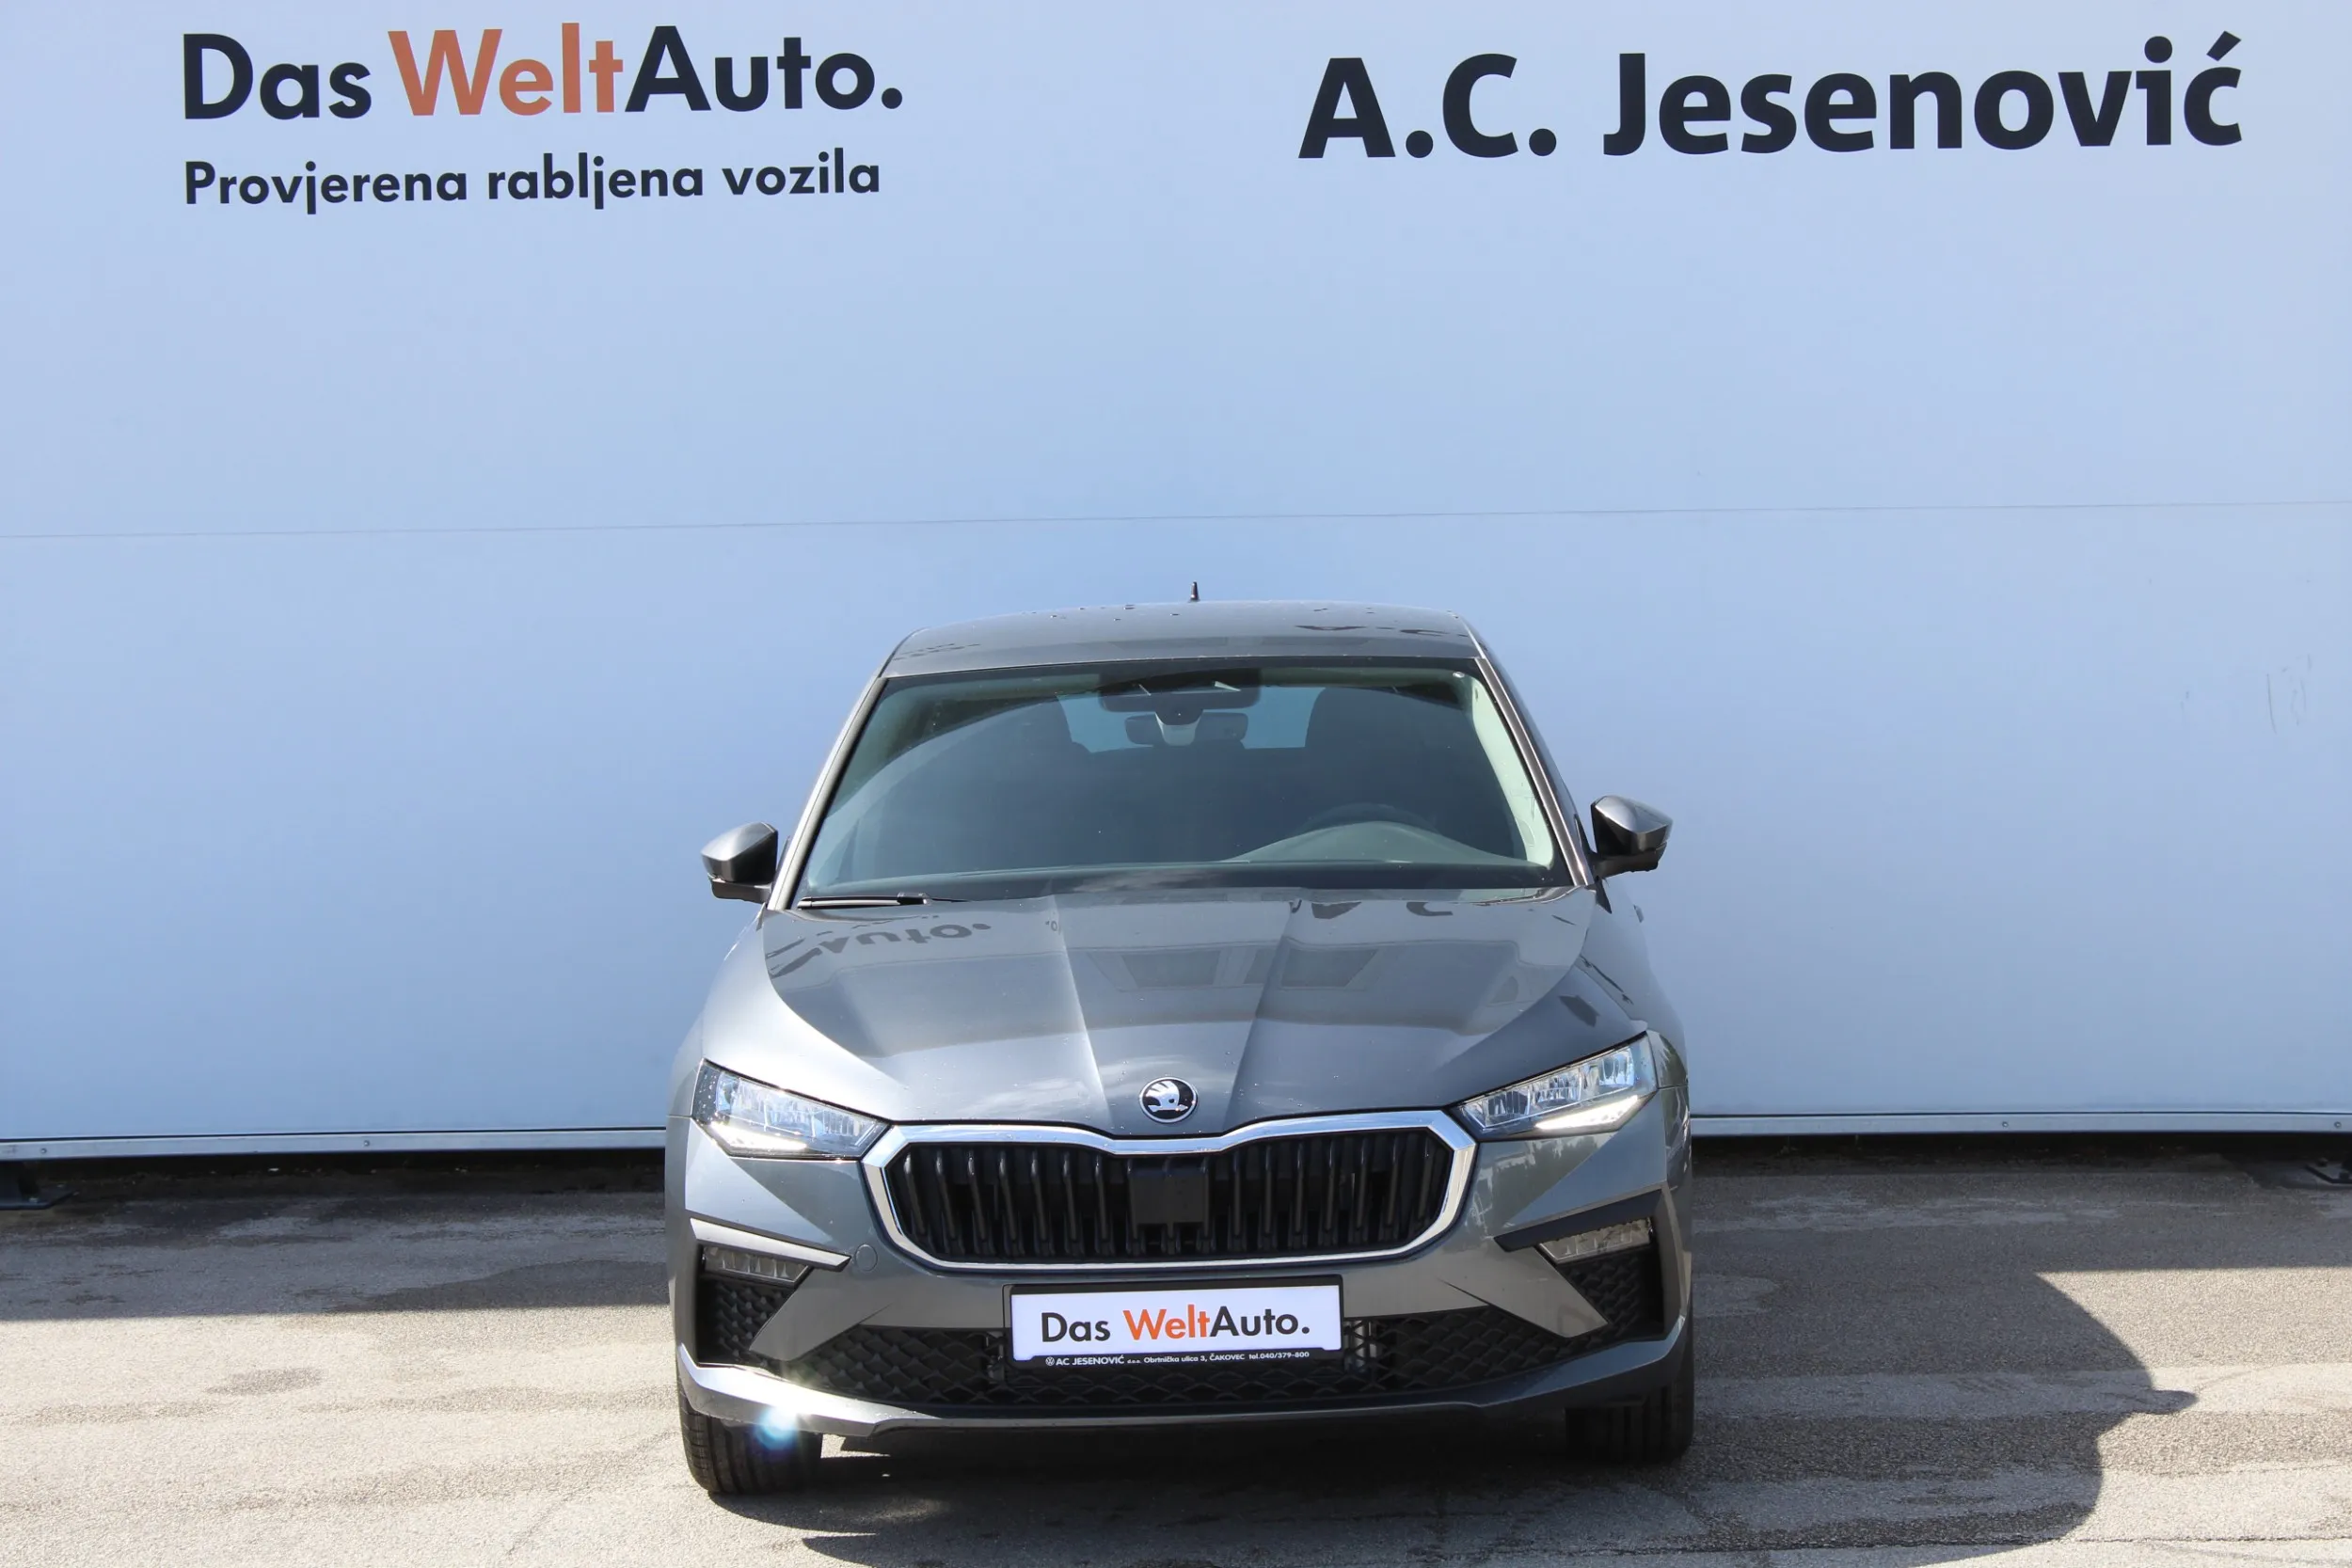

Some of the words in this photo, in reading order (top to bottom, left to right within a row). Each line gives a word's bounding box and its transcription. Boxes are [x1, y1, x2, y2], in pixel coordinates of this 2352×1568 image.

[183, 34, 372, 119] Das
[389, 24, 902, 115] WeltAuto.
[1298, 54, 1556, 158] A.C.
[1603, 31, 2242, 156] Jesenović
[186, 161, 467, 214] Provjerena
[489, 152, 703, 210] rabljena
[722, 148, 879, 195] vozila
[1041, 1313, 1110, 1342] Das
[1123, 1305, 1310, 1339] WeltAuto.
[1056, 1357, 1070, 1366] AC
[1072, 1354, 1125, 1365] JESENOVIĆ
[1209, 1352, 1245, 1361] ČAKOVEC
